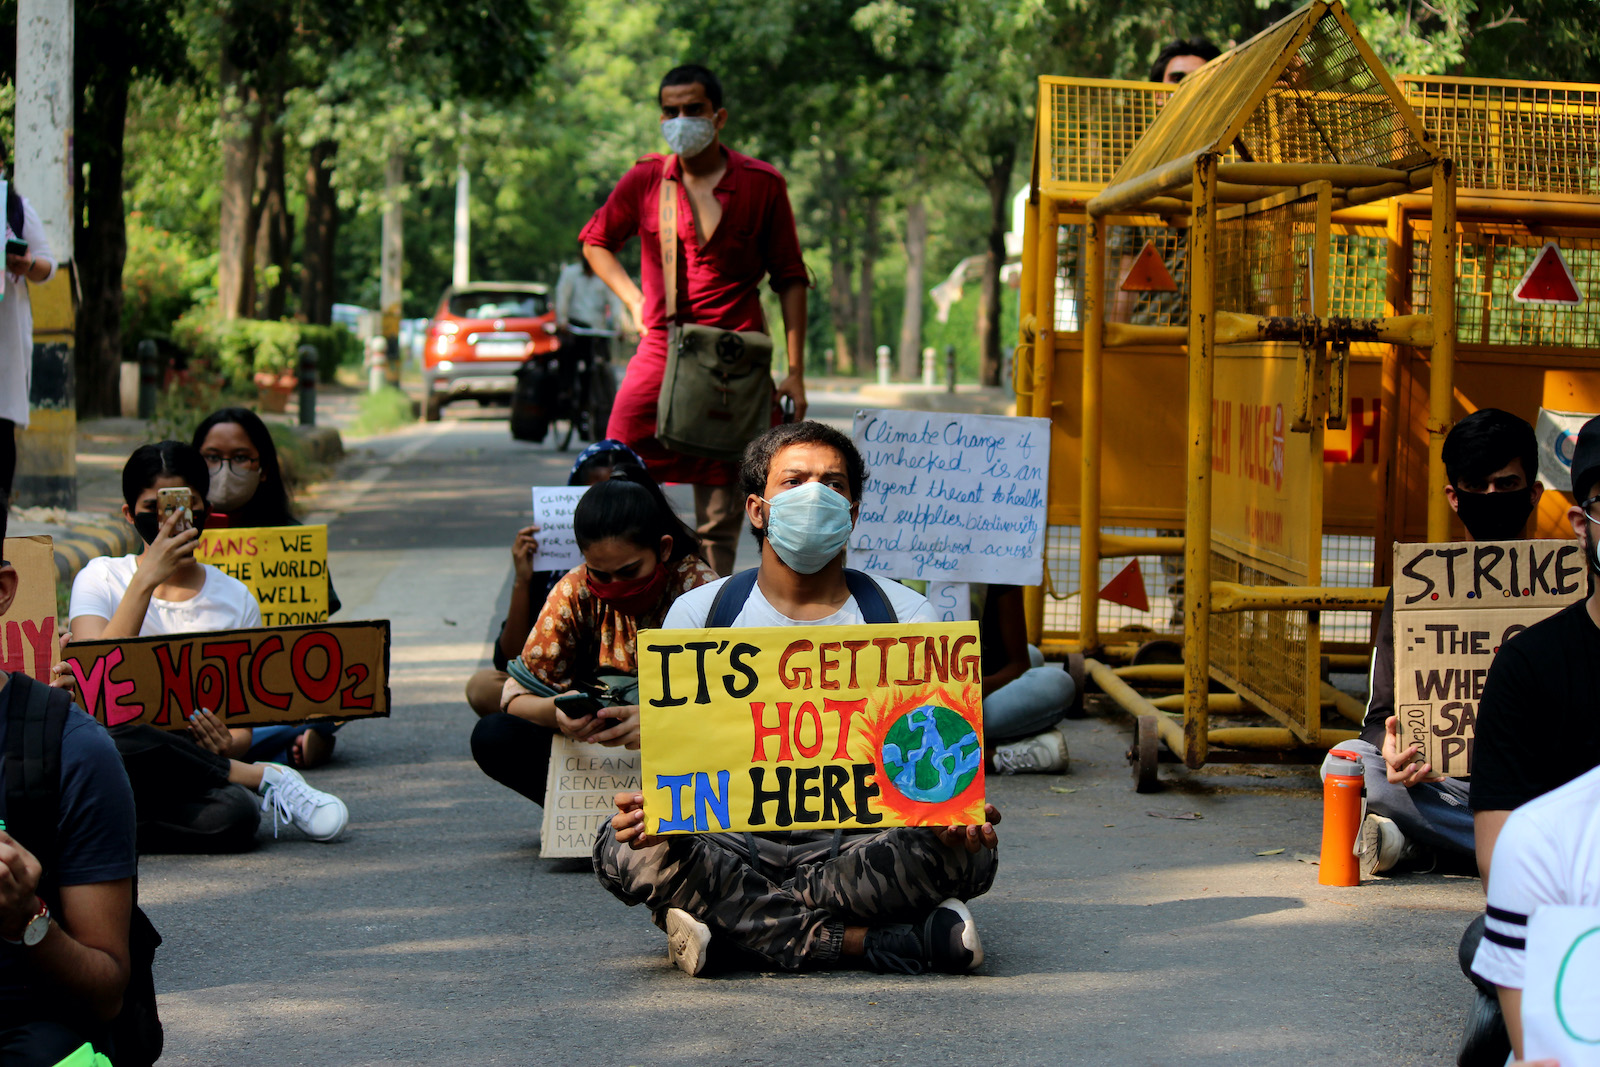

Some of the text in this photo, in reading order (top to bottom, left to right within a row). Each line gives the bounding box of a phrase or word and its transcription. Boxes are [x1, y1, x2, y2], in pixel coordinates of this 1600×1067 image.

[865, 418, 1037, 463] Climate Change if
[1239, 402, 1271, 486] POLICE
[981, 458, 1010, 478] is
[1014, 464, 1042, 481] an
[863, 475, 917, 504] urgent
[280, 535, 312, 553] WE
[980, 544, 1033, 559] across
[261, 560, 326, 580] WORLD!
[863, 554, 893, 571] the
[647, 635, 981, 707] IT'S GETTING
[750, 697, 868, 763] HOT
[565, 757, 635, 771] CLEAN
[657, 763, 883, 834] IN HERE
